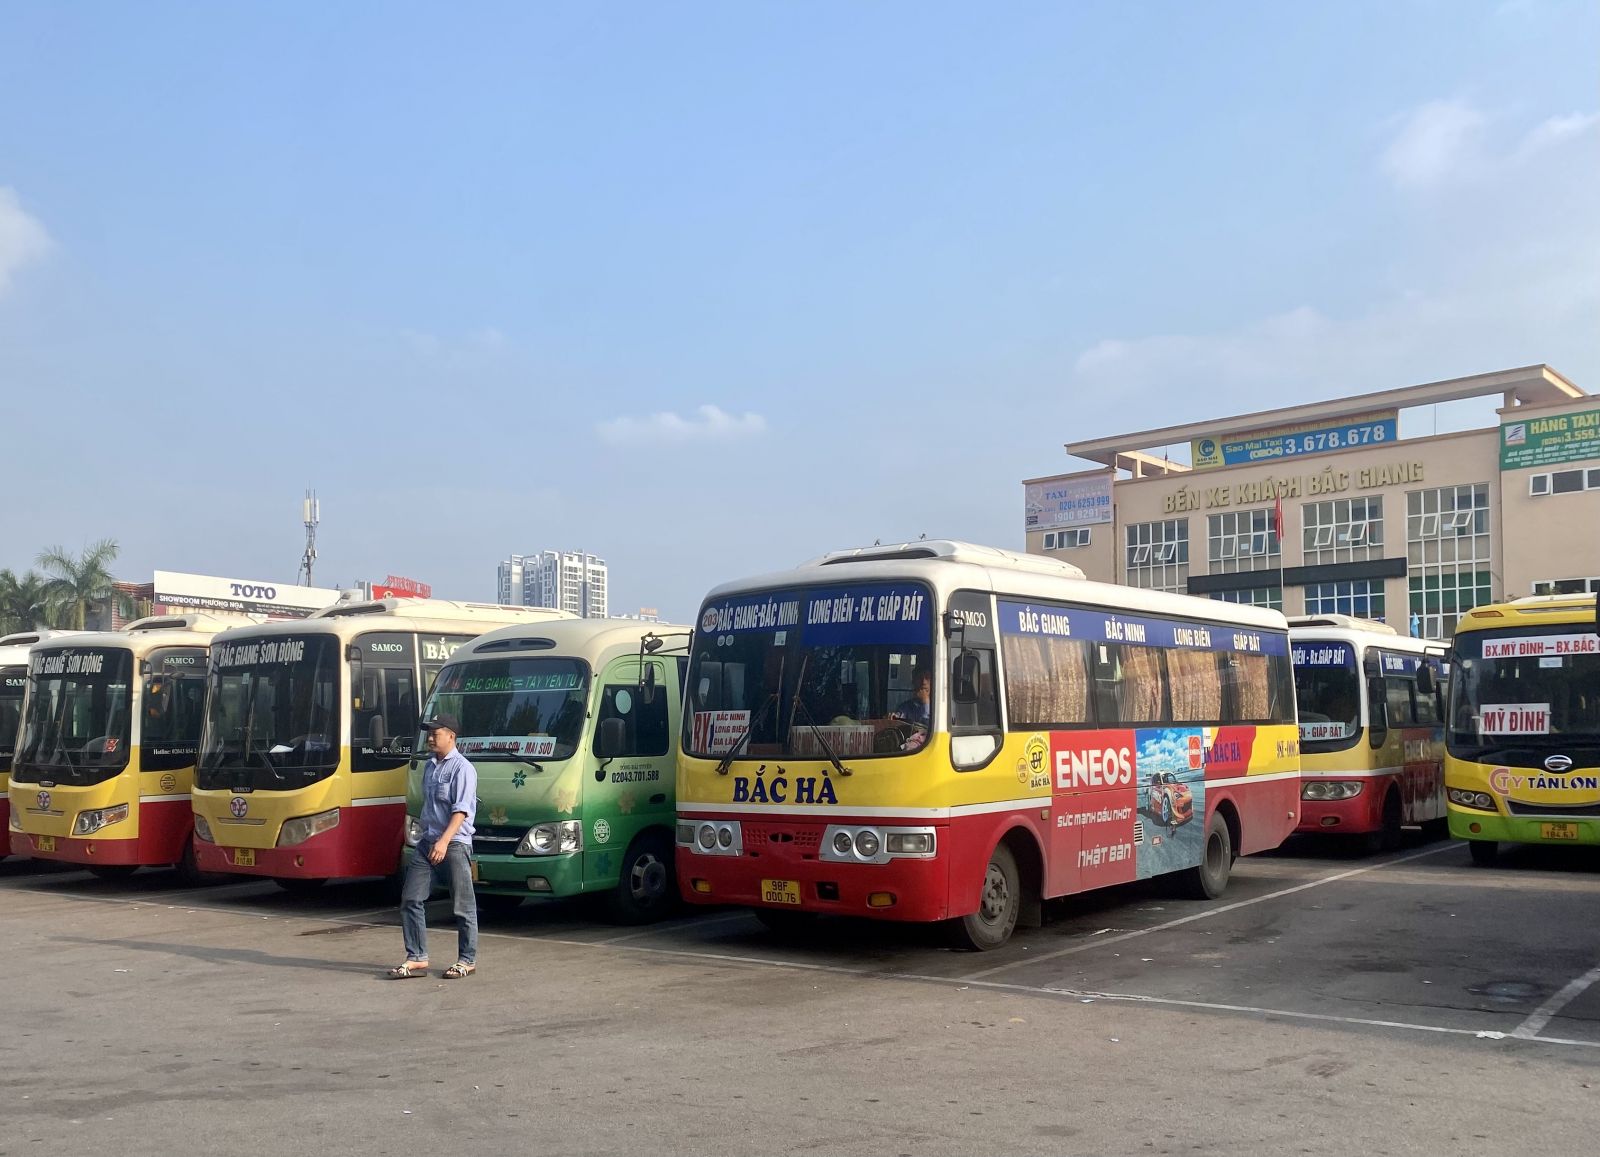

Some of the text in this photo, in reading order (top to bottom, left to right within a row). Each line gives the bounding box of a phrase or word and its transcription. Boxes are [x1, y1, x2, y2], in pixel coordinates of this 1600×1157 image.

[1571, 413, 1600, 428] TAXI
[1285, 425, 1385, 454] 3.678.678
[1565, 428, 1600, 441] 3.559.
[1045, 490, 1067, 500] TAXI
[1164, 460, 1425, 514] BẾN XE KHÁCH BẮC GIANG
[159, 595, 200, 605] SHOWROOM
[230, 583, 276, 600] TOTO
[777, 601, 800, 626] NINH
[808, 599, 831, 624] LONG
[832, 593, 854, 623] BIÊN
[877, 590, 901, 621] GIÁP
[902, 590, 923, 621] BÁT
[953, 609, 986, 627] SAMCO
[1018, 605, 1070, 636] BẮC GIANG
[1105, 616, 1146, 643] BẮC NINH
[1173, 627, 1211, 647] LONG BIÊN
[371, 643, 402, 651] SAMCO
[1233, 632, 1248, 650] GIÁP
[1519, 640, 1544, 655] ĐÌNH
[235, 644, 259, 666] GIANG
[278, 638, 304, 665] ĐỘNG
[1333, 646, 1345, 664] BÁT
[44, 656, 65, 673] GIANG
[6, 678, 26, 686] SAM
[485, 677, 512, 690] GIANG
[730, 712, 746, 720] NINH
[1484, 707, 1545, 732] MỸ ĐÌNH
[715, 725, 730, 733] LONG
[1312, 724, 1328, 738] GIÁP
[1056, 747, 1132, 789] ENEOS
[733, 765, 838, 804] BẮC HÀ
[771, 881, 789, 891] 98F
